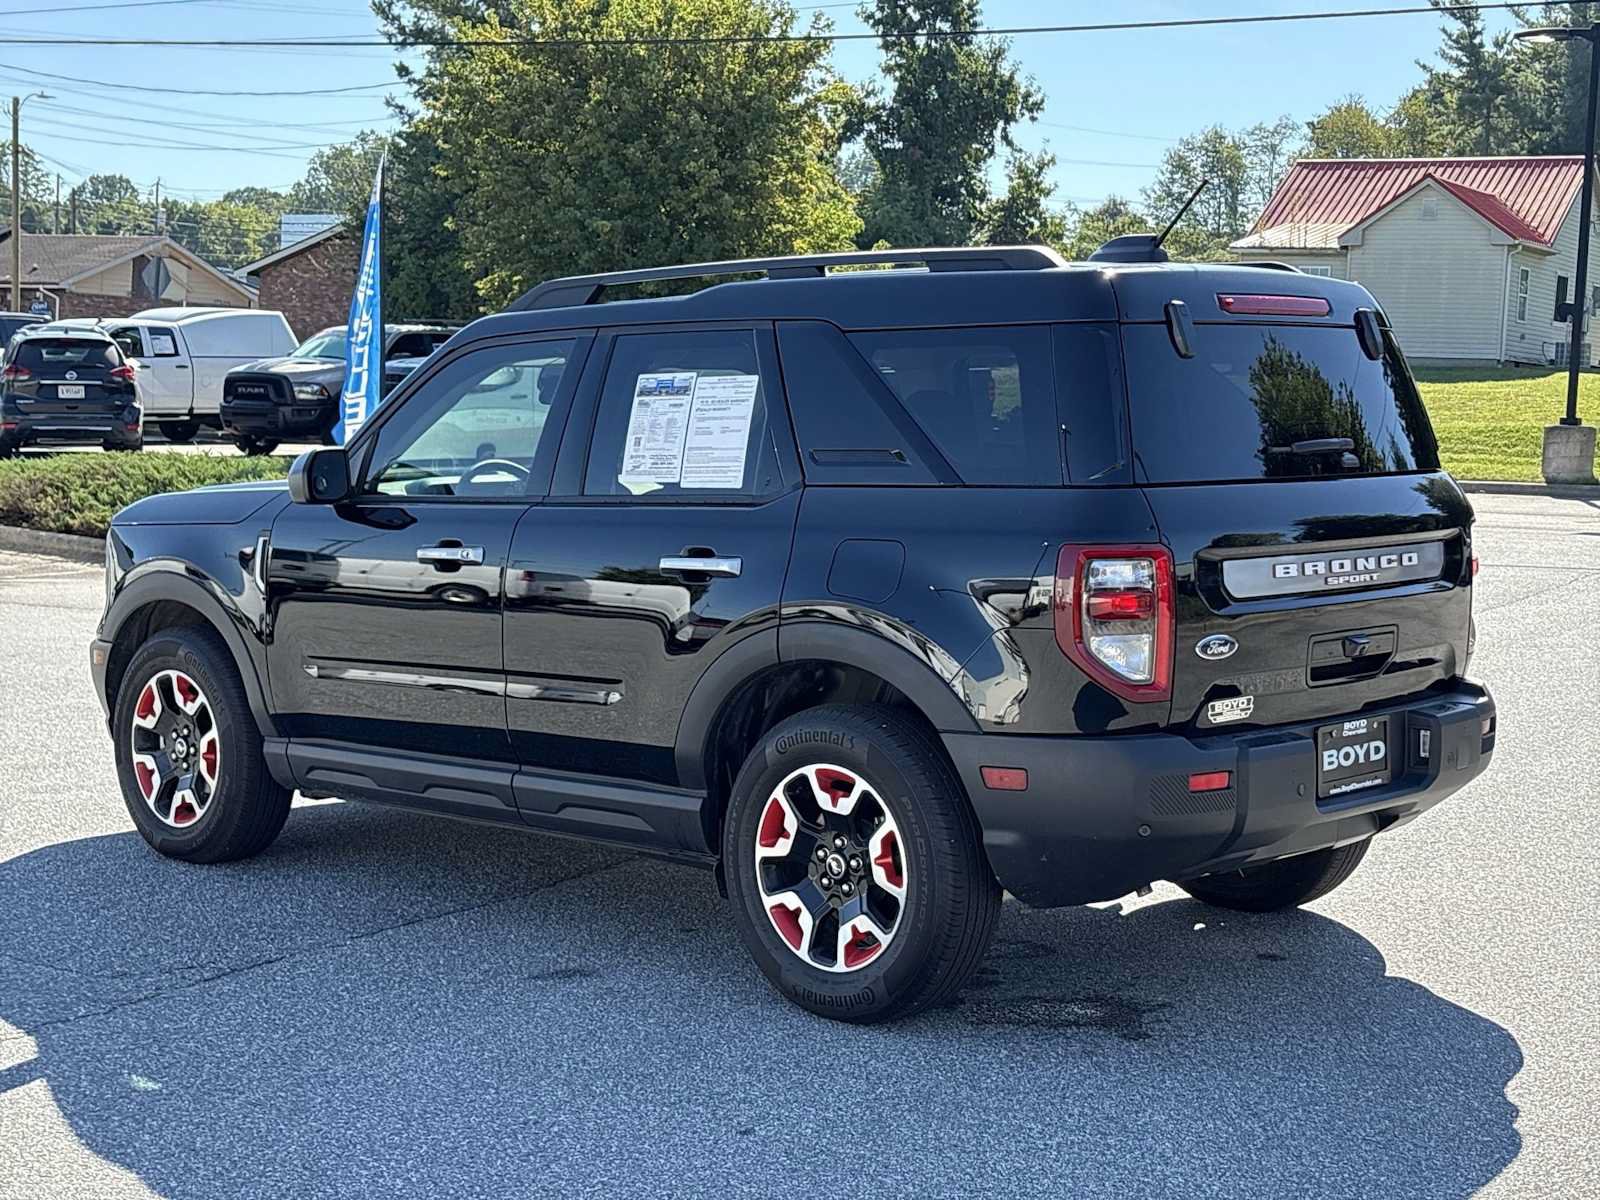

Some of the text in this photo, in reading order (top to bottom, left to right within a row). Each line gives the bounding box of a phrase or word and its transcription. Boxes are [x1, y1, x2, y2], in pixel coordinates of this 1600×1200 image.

[1273, 551, 1419, 579] BRONCO
[1325, 572, 1382, 586] SPORT
[1215, 699, 1247, 712] BOYD
[1342, 727, 1367, 737] Chevrolet
[1343, 718, 1368, 730] BOYD
[775, 728, 845, 755] Continental
[1322, 740, 1386, 772] BOYD
[802, 986, 875, 1010] Continental
